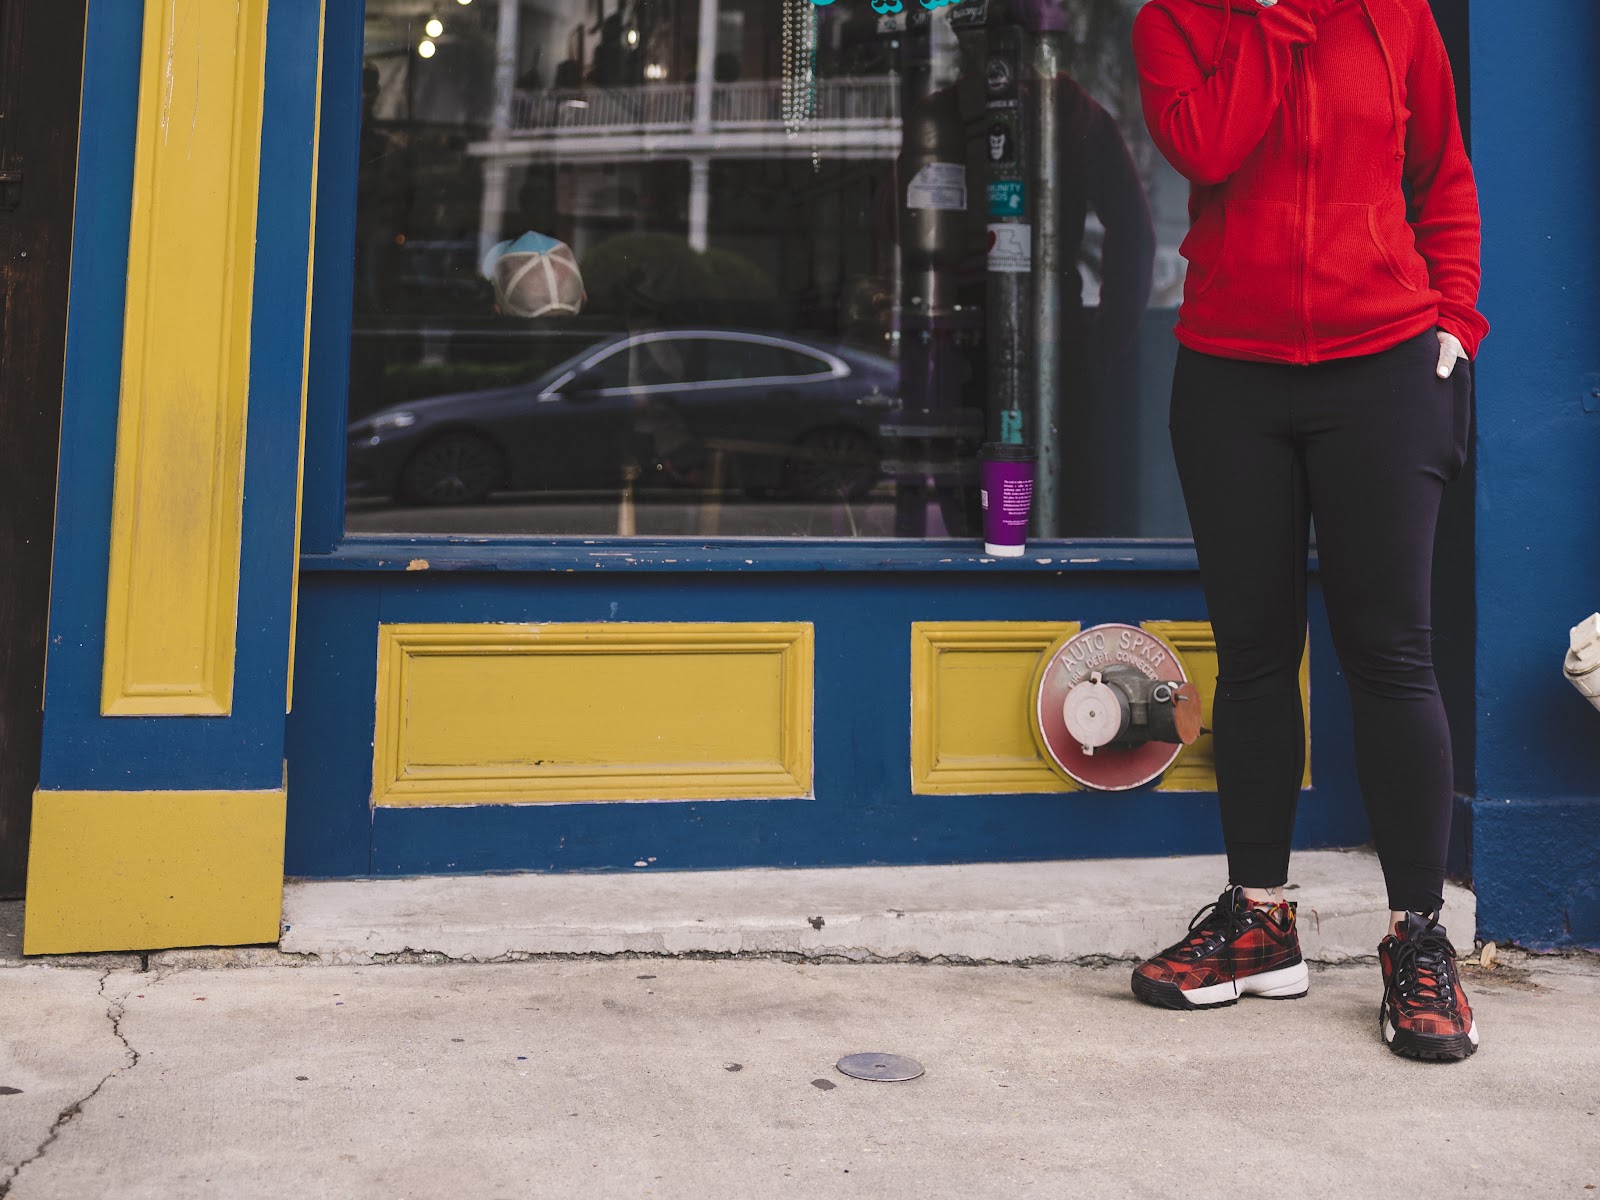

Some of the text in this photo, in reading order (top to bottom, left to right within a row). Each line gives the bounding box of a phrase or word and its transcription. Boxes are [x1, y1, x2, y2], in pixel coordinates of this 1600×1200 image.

[1060, 630, 1166, 673] AUTO SPKR
[1085, 651, 1113, 669] DEPT.
